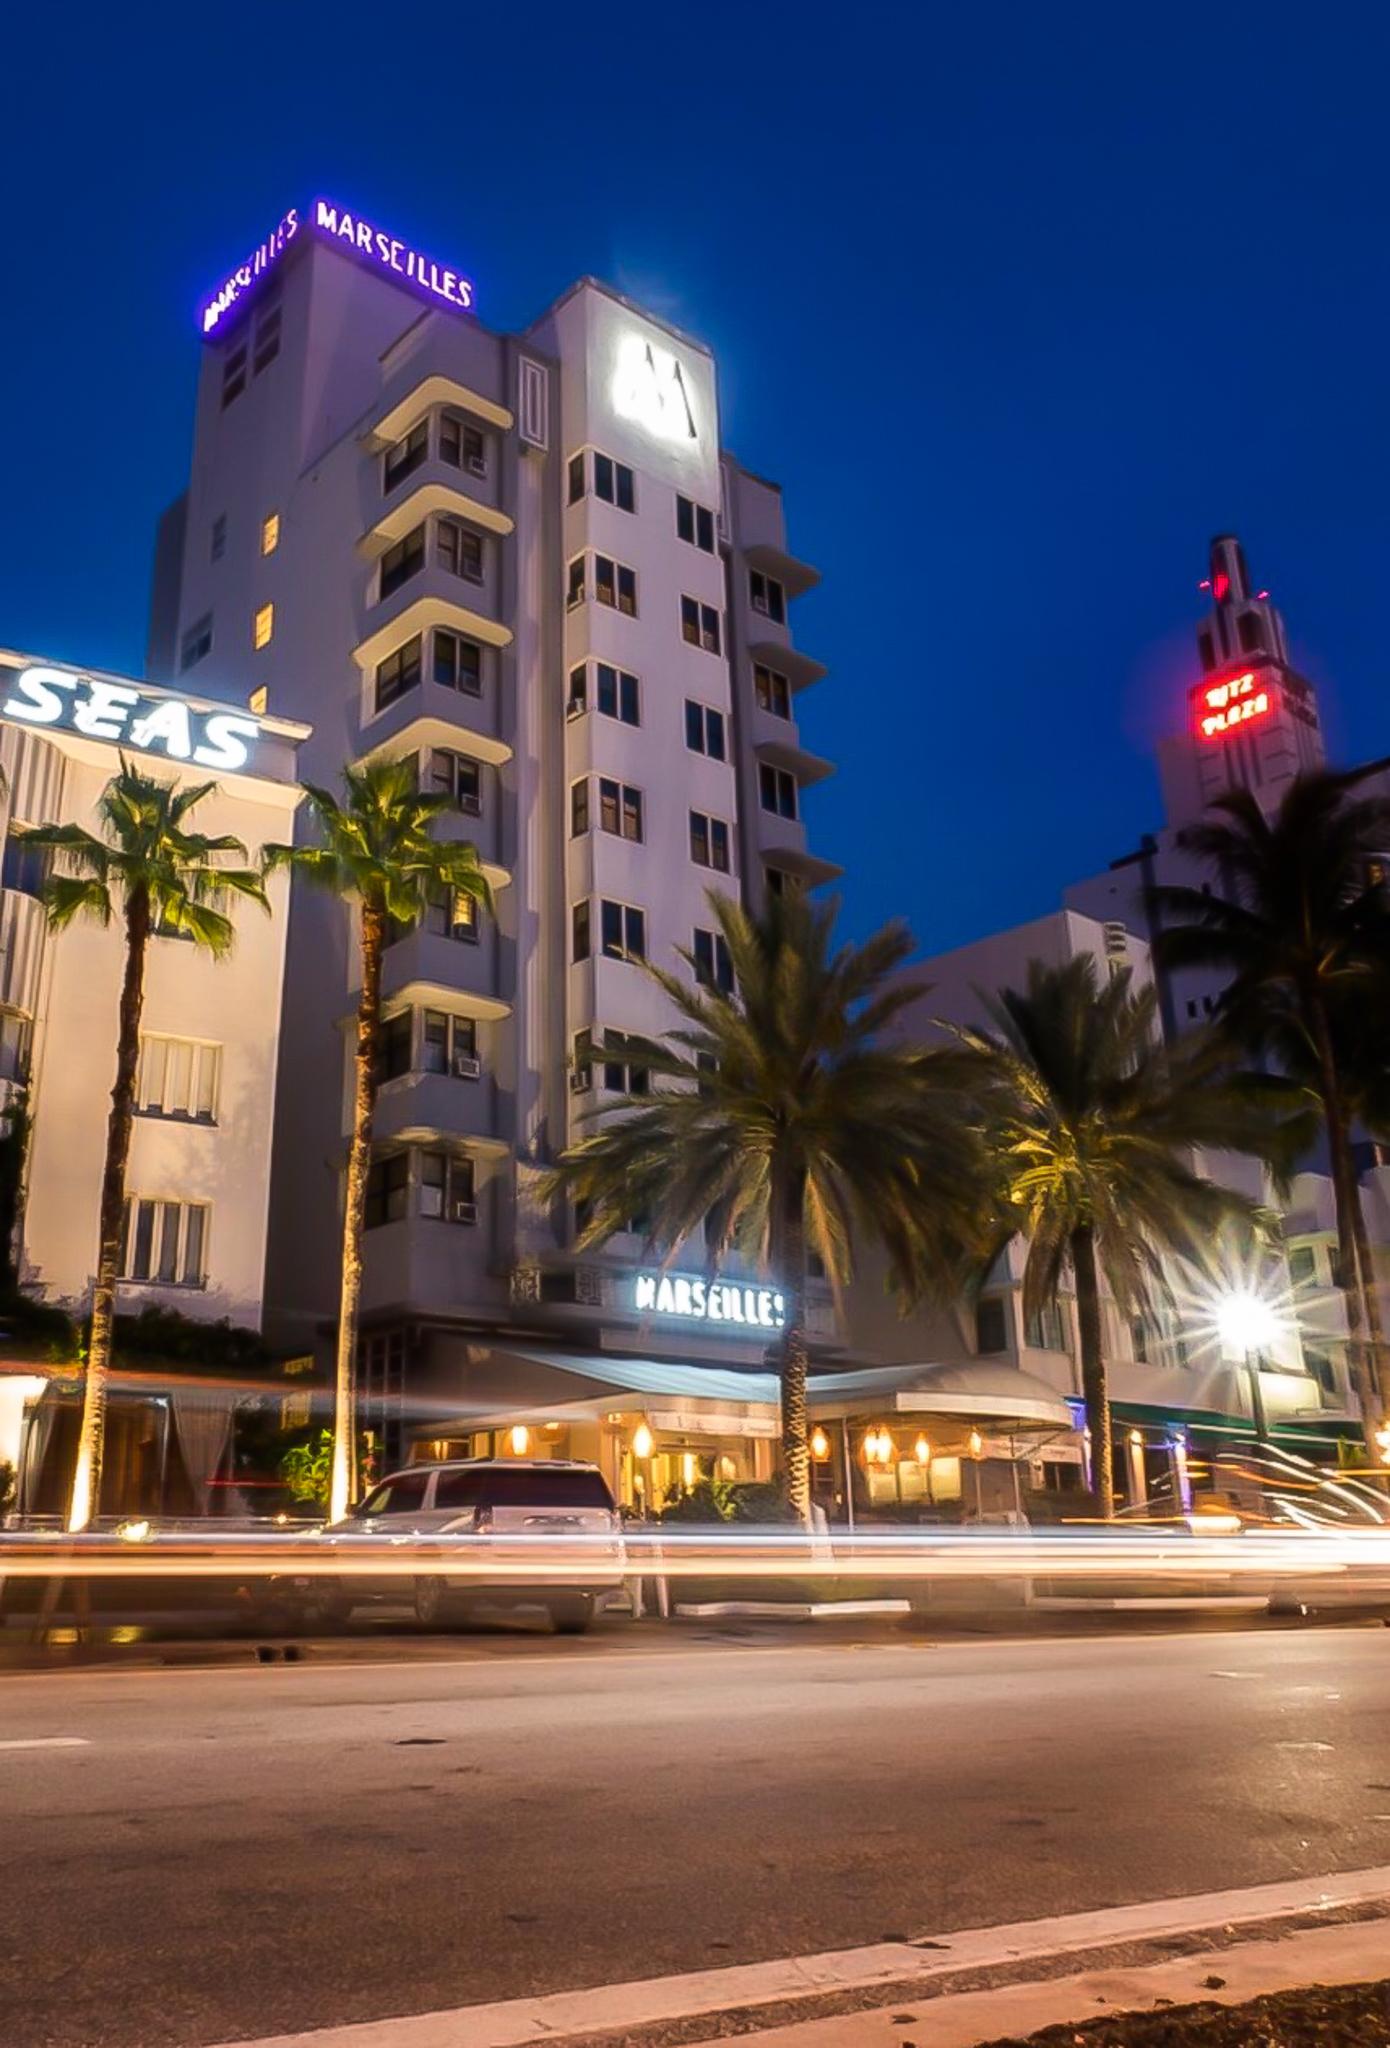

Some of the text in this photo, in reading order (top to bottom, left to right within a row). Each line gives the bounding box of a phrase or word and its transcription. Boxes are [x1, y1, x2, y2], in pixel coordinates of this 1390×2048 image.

[316, 201, 473, 308] MARSEILLES
[2, 667, 260, 770] SEAS
[635, 1275, 785, 1327] MARSEILLES
